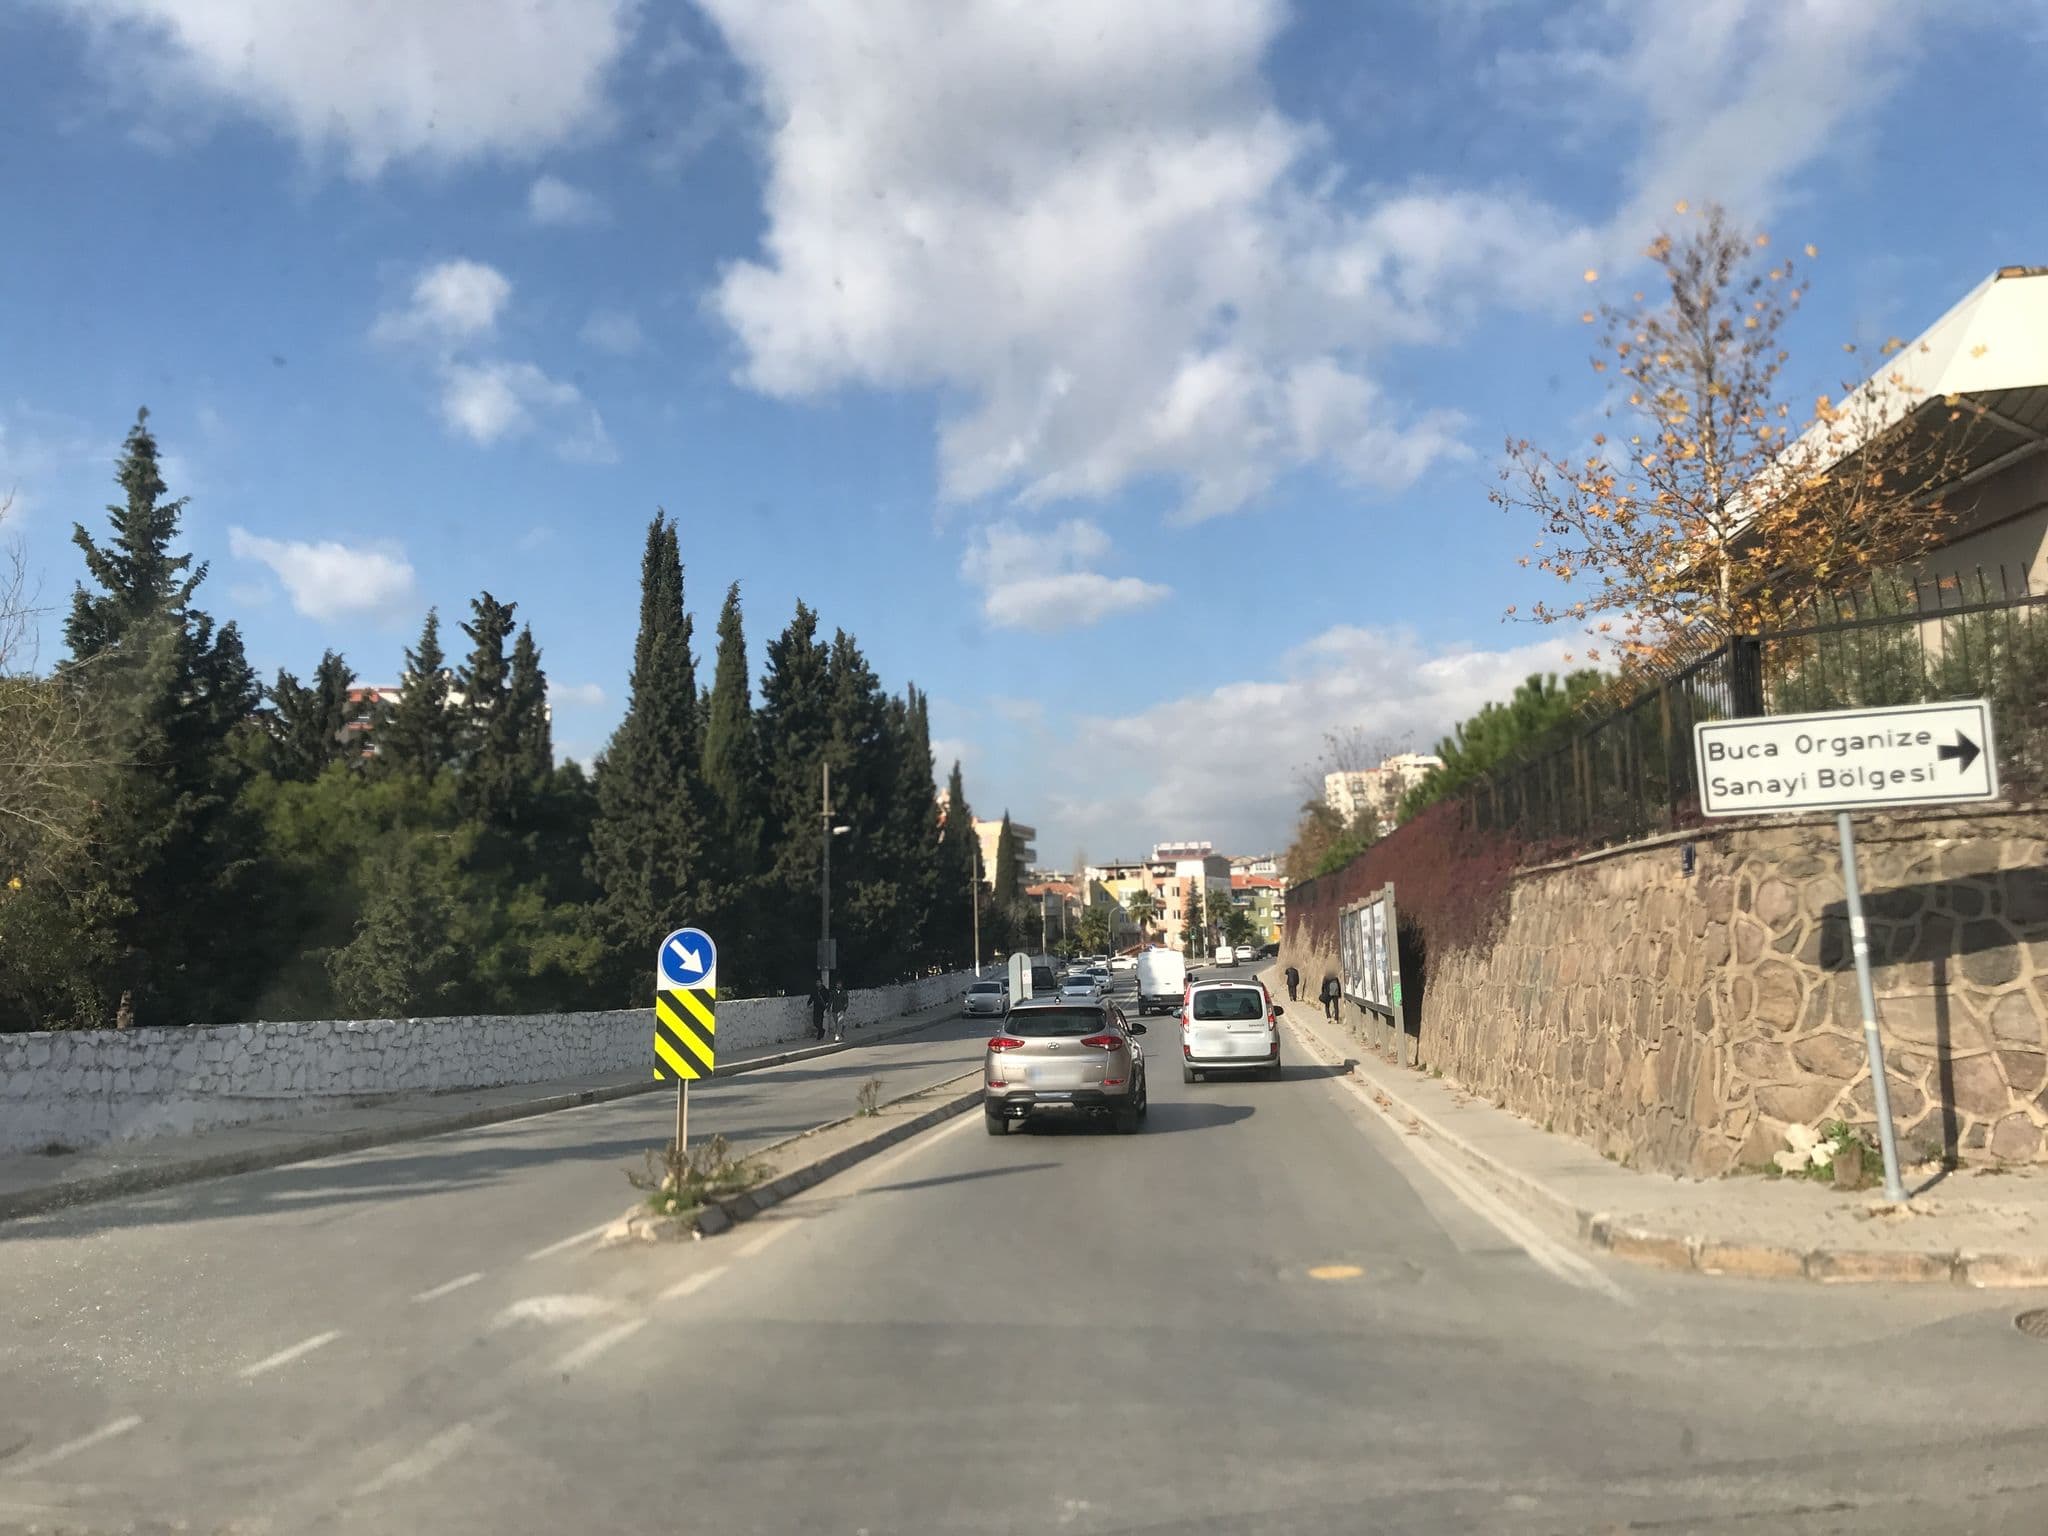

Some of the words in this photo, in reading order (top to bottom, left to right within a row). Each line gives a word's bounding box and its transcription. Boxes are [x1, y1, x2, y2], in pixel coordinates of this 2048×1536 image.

[1708, 741, 1779, 761] Buca
[1795, 729, 1932, 756] Organize
[1711, 772, 1807, 797] Sanayi
[1818, 763, 1936, 790] Bölgesi
